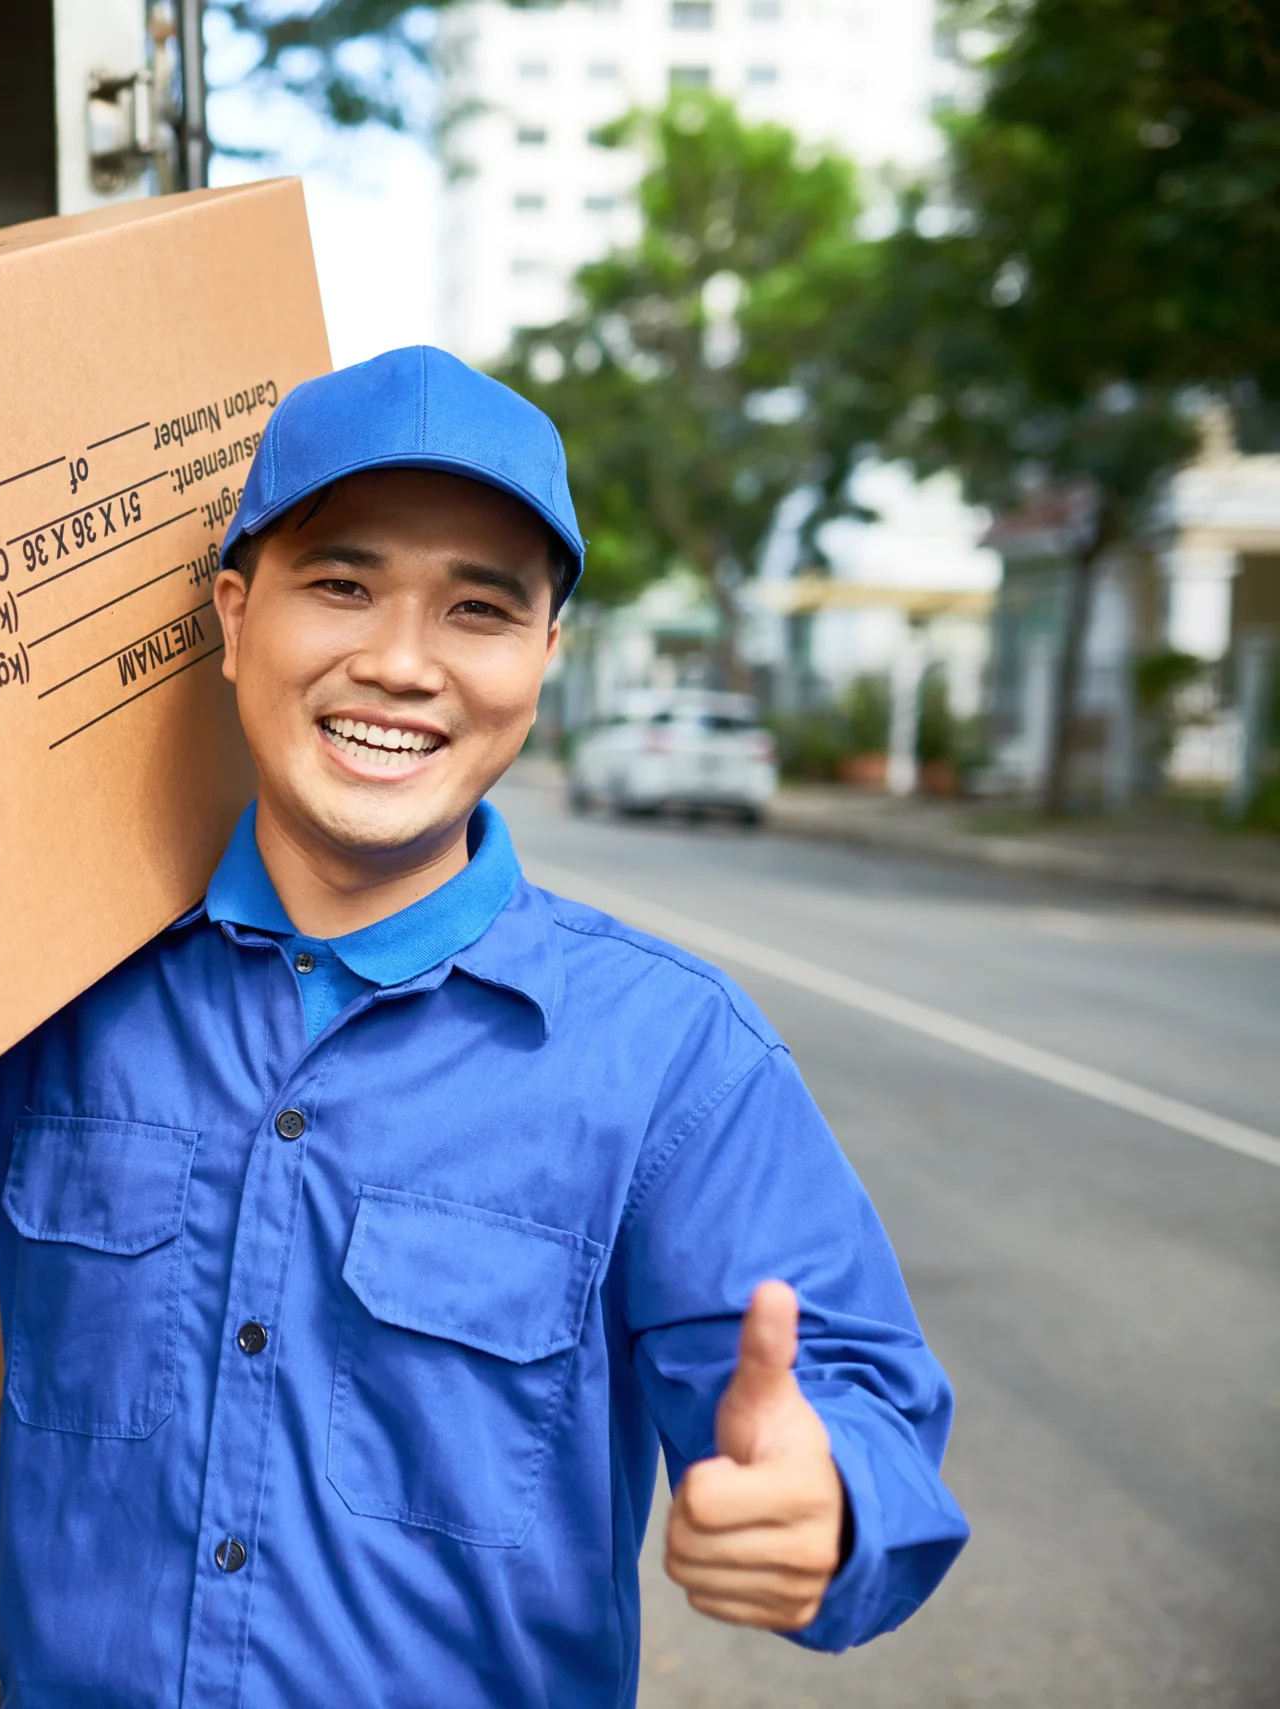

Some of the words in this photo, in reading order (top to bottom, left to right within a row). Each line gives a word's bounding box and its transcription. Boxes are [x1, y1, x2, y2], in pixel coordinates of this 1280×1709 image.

[223, 380, 278, 419] Carton
[153, 402, 222, 450] Number
[69, 457, 89, 494] of
[170, 431, 264, 495] asurement:
[98, 502, 117, 537] X
[120, 491, 142, 528] 51
[50, 523, 70, 560] X
[71, 512, 97, 549] 36
[22, 534, 49, 572] 36
[186, 542, 223, 587] ght:
[117, 615, 206, 687] VIETNAM
